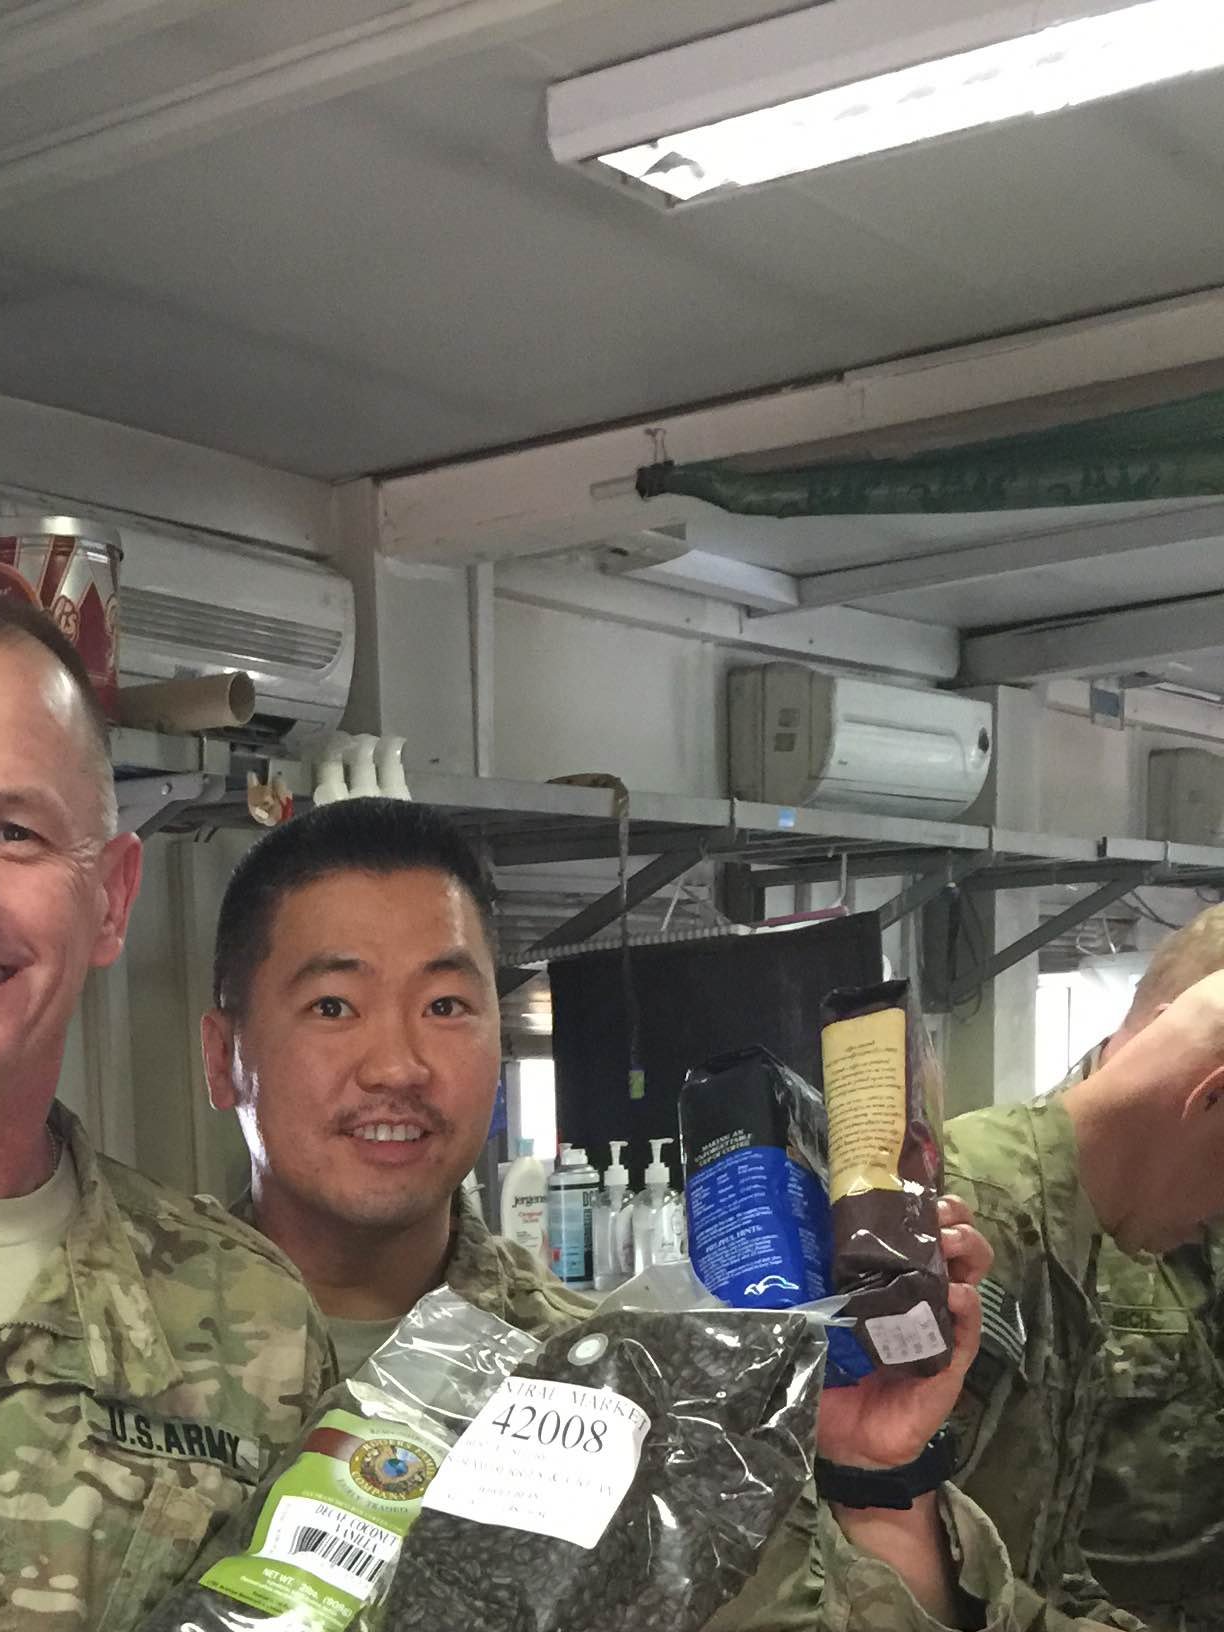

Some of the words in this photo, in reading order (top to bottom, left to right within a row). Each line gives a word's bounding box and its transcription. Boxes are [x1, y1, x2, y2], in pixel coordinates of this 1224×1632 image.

[492, 1403, 608, 1453] 42008
[572, 1390, 649, 1431] MARKET
[315, 1504, 349, 1522] DECAF
[349, 1516, 399, 1547] COCONUT
[334, 1525, 378, 1554] VANILLA
